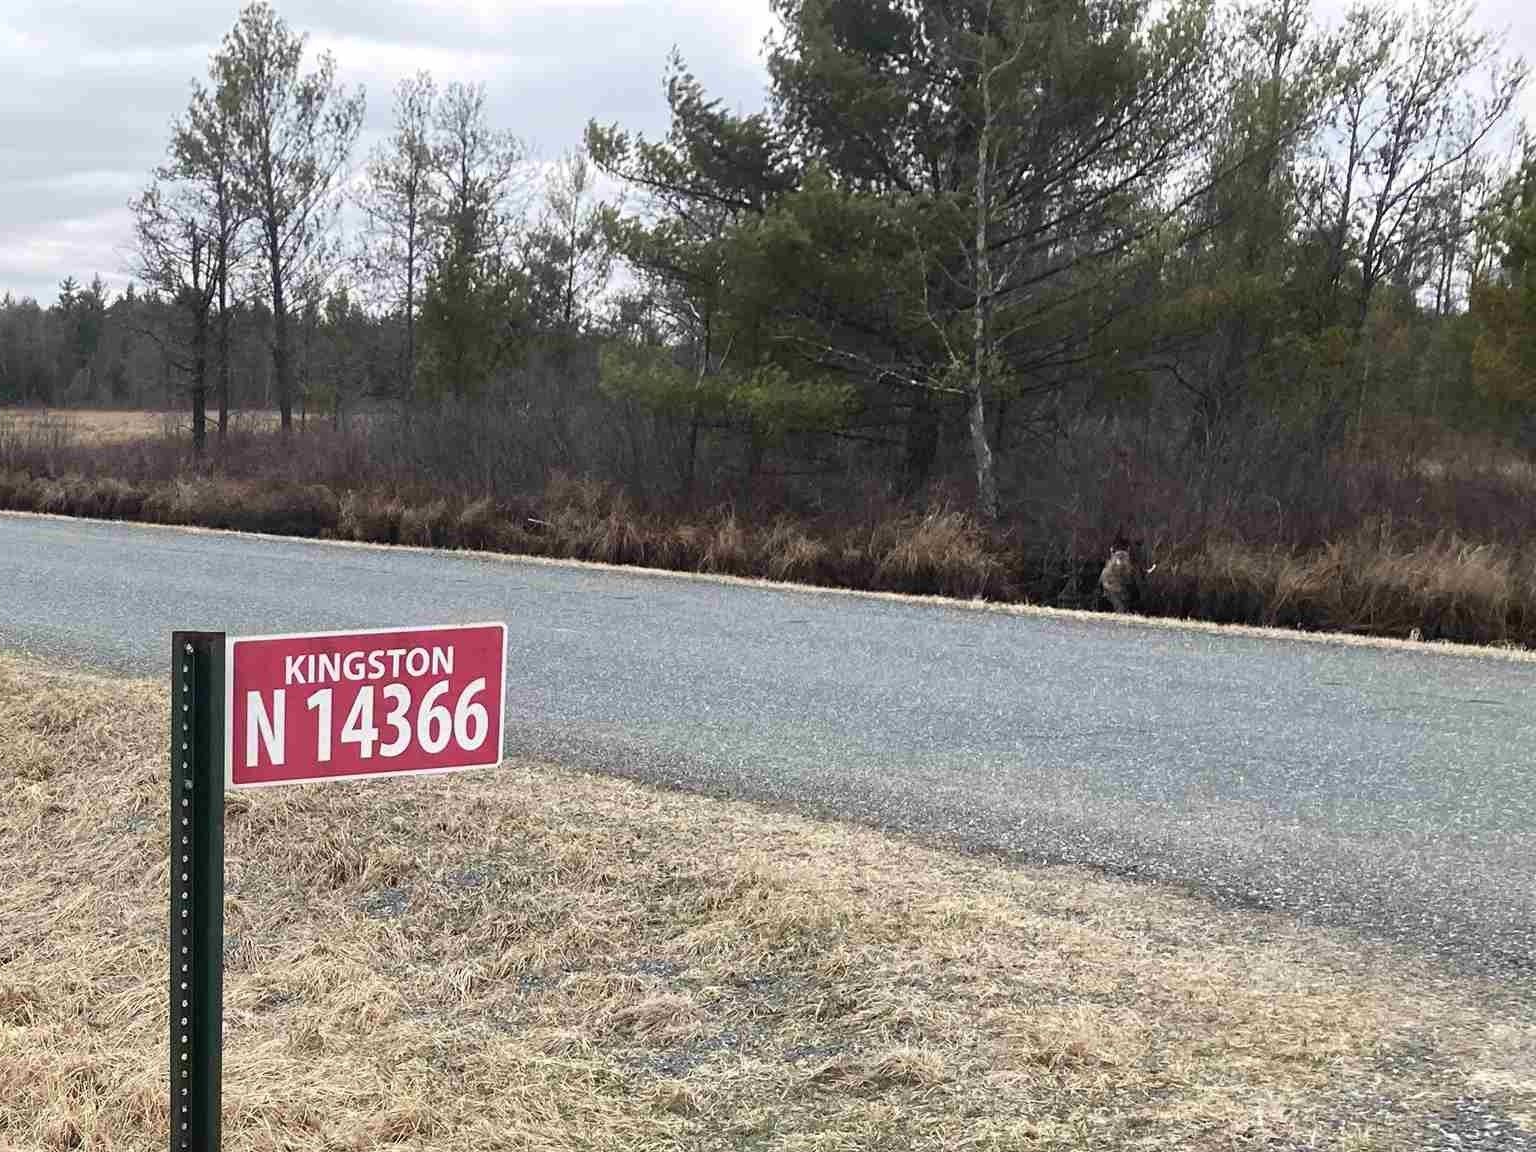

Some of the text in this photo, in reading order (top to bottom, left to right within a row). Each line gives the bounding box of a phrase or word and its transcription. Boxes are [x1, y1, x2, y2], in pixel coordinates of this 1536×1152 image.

[284, 645, 454, 685] KINGSTON
[245, 677, 489, 768] N 14366
